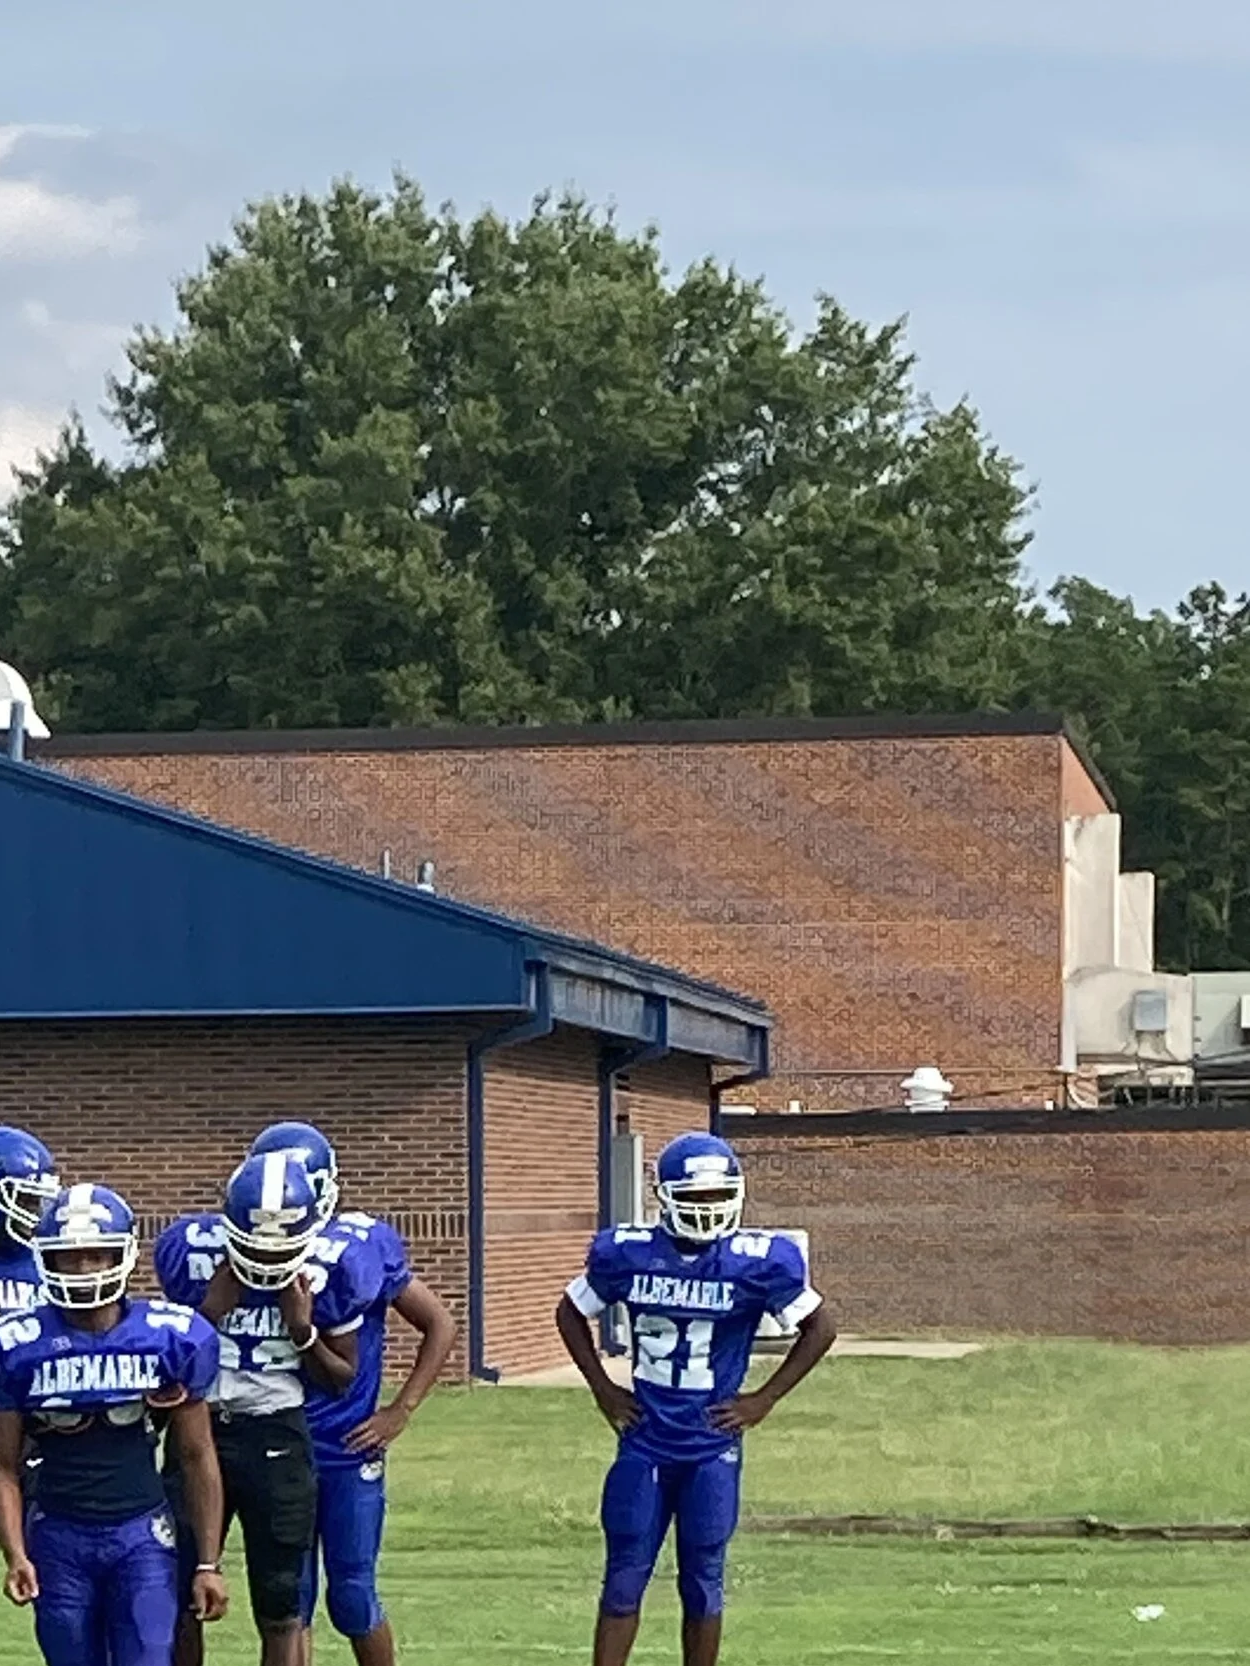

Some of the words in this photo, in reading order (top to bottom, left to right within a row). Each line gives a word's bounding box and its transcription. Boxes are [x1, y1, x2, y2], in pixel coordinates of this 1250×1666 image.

[627, 1274, 735, 1311] ALBEMARLE
[634, 1313, 715, 1390] 21
[28, 1354, 162, 1396] ALBEMARLE
